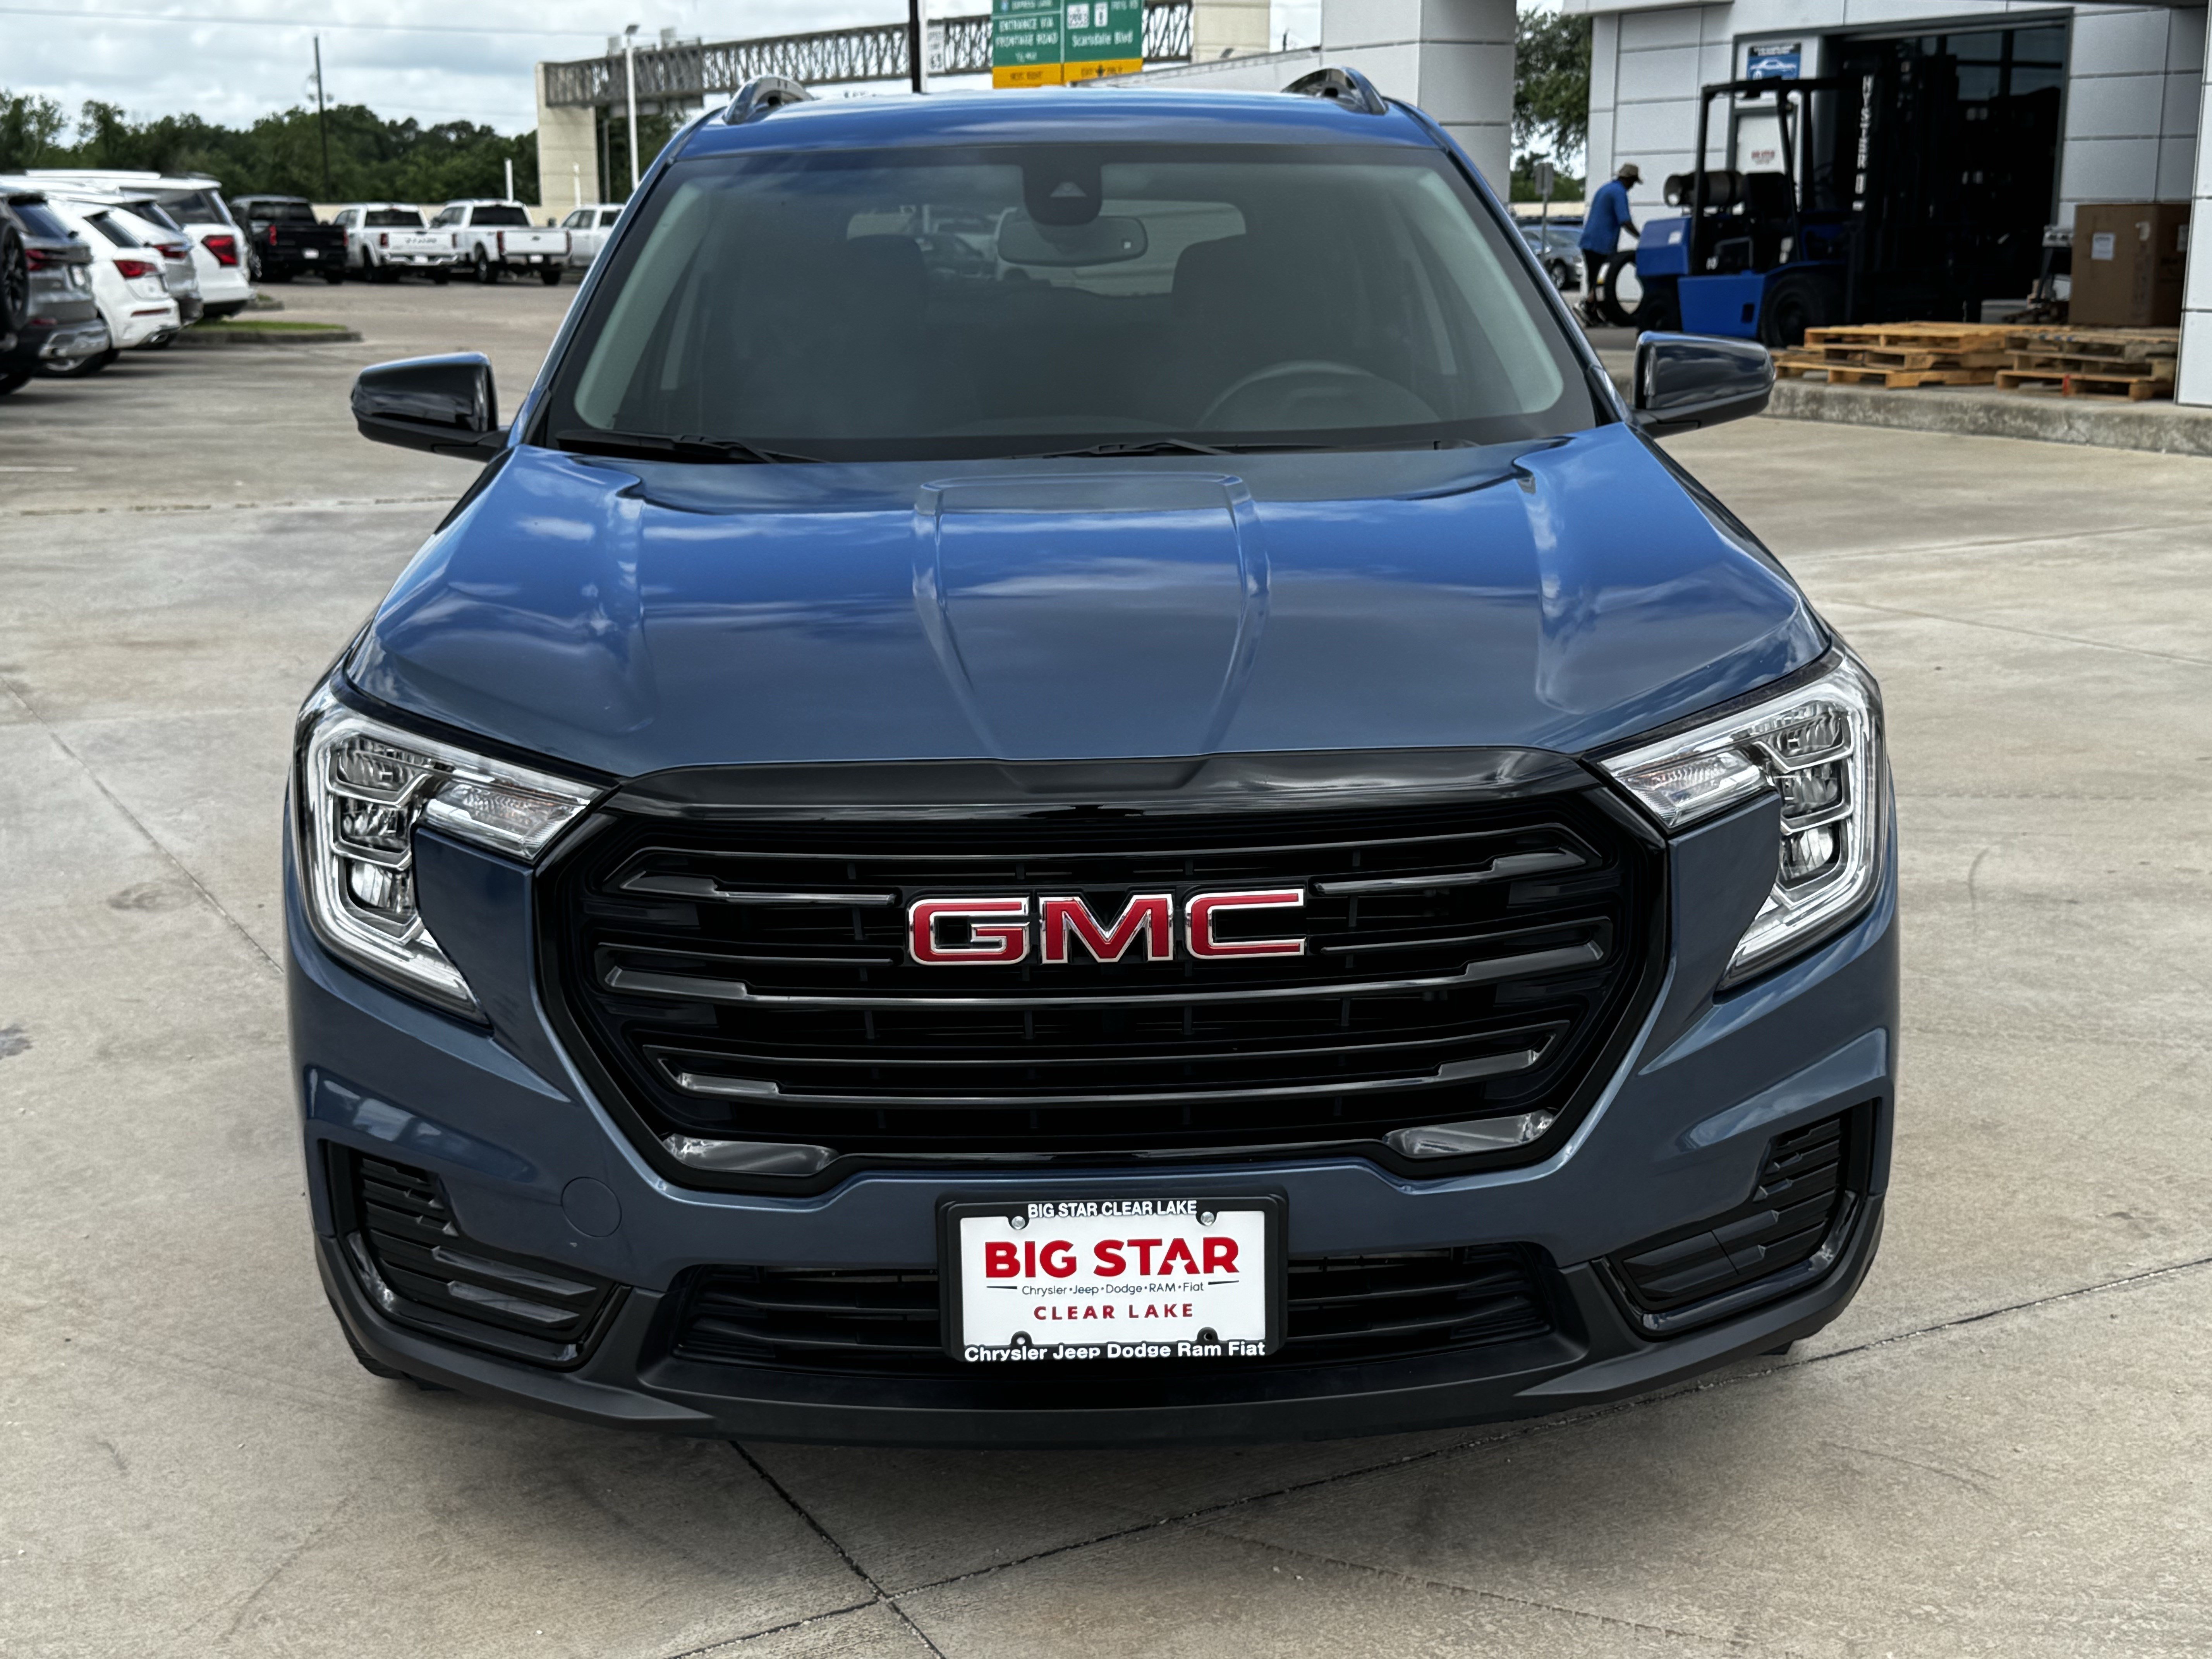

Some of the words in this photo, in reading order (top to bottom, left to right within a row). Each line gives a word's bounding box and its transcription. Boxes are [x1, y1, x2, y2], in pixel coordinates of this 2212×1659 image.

[999, 18, 1037, 33] ENTRANCE
[1040, 16, 1054, 29] VIA
[995, 34, 1034, 48] FRONTAGE
[1036, 32, 1058, 45] ROAD
[1072, 33, 1111, 47] Scarsdale
[1114, 31, 1133, 44] Blvd
[1857, 75, 1874, 169] HYSTER
[908, 888, 1306, 966] GMC
[1028, 1203, 1054, 1218] BIG
[1058, 1202, 1097, 1217] STAR
[1102, 1201, 1152, 1216] CLEAR
[1157, 1200, 1197, 1215] LAKE
[985, 1240, 1077, 1278] BIG
[1093, 1237, 1240, 1277] STAR
[1022, 1285, 1067, 1297] Chrysler
[1072, 1285, 1099, 1296] Jeep
[1106, 1284, 1142, 1295] Dodge
[1149, 1283, 1176, 1292] RAM
[1183, 1282, 1204, 1291] Fiat
[1034, 1305, 1115, 1320] CLEAR
[1128, 1303, 1193, 1318] LAKE
[964, 1345, 1048, 1362] Chrysler
[1053, 1345, 1101, 1360] Jeep
[1107, 1343, 1171, 1358] Dodge
[1177, 1342, 1221, 1357] Ram
[1228, 1341, 1266, 1355] Fiat
